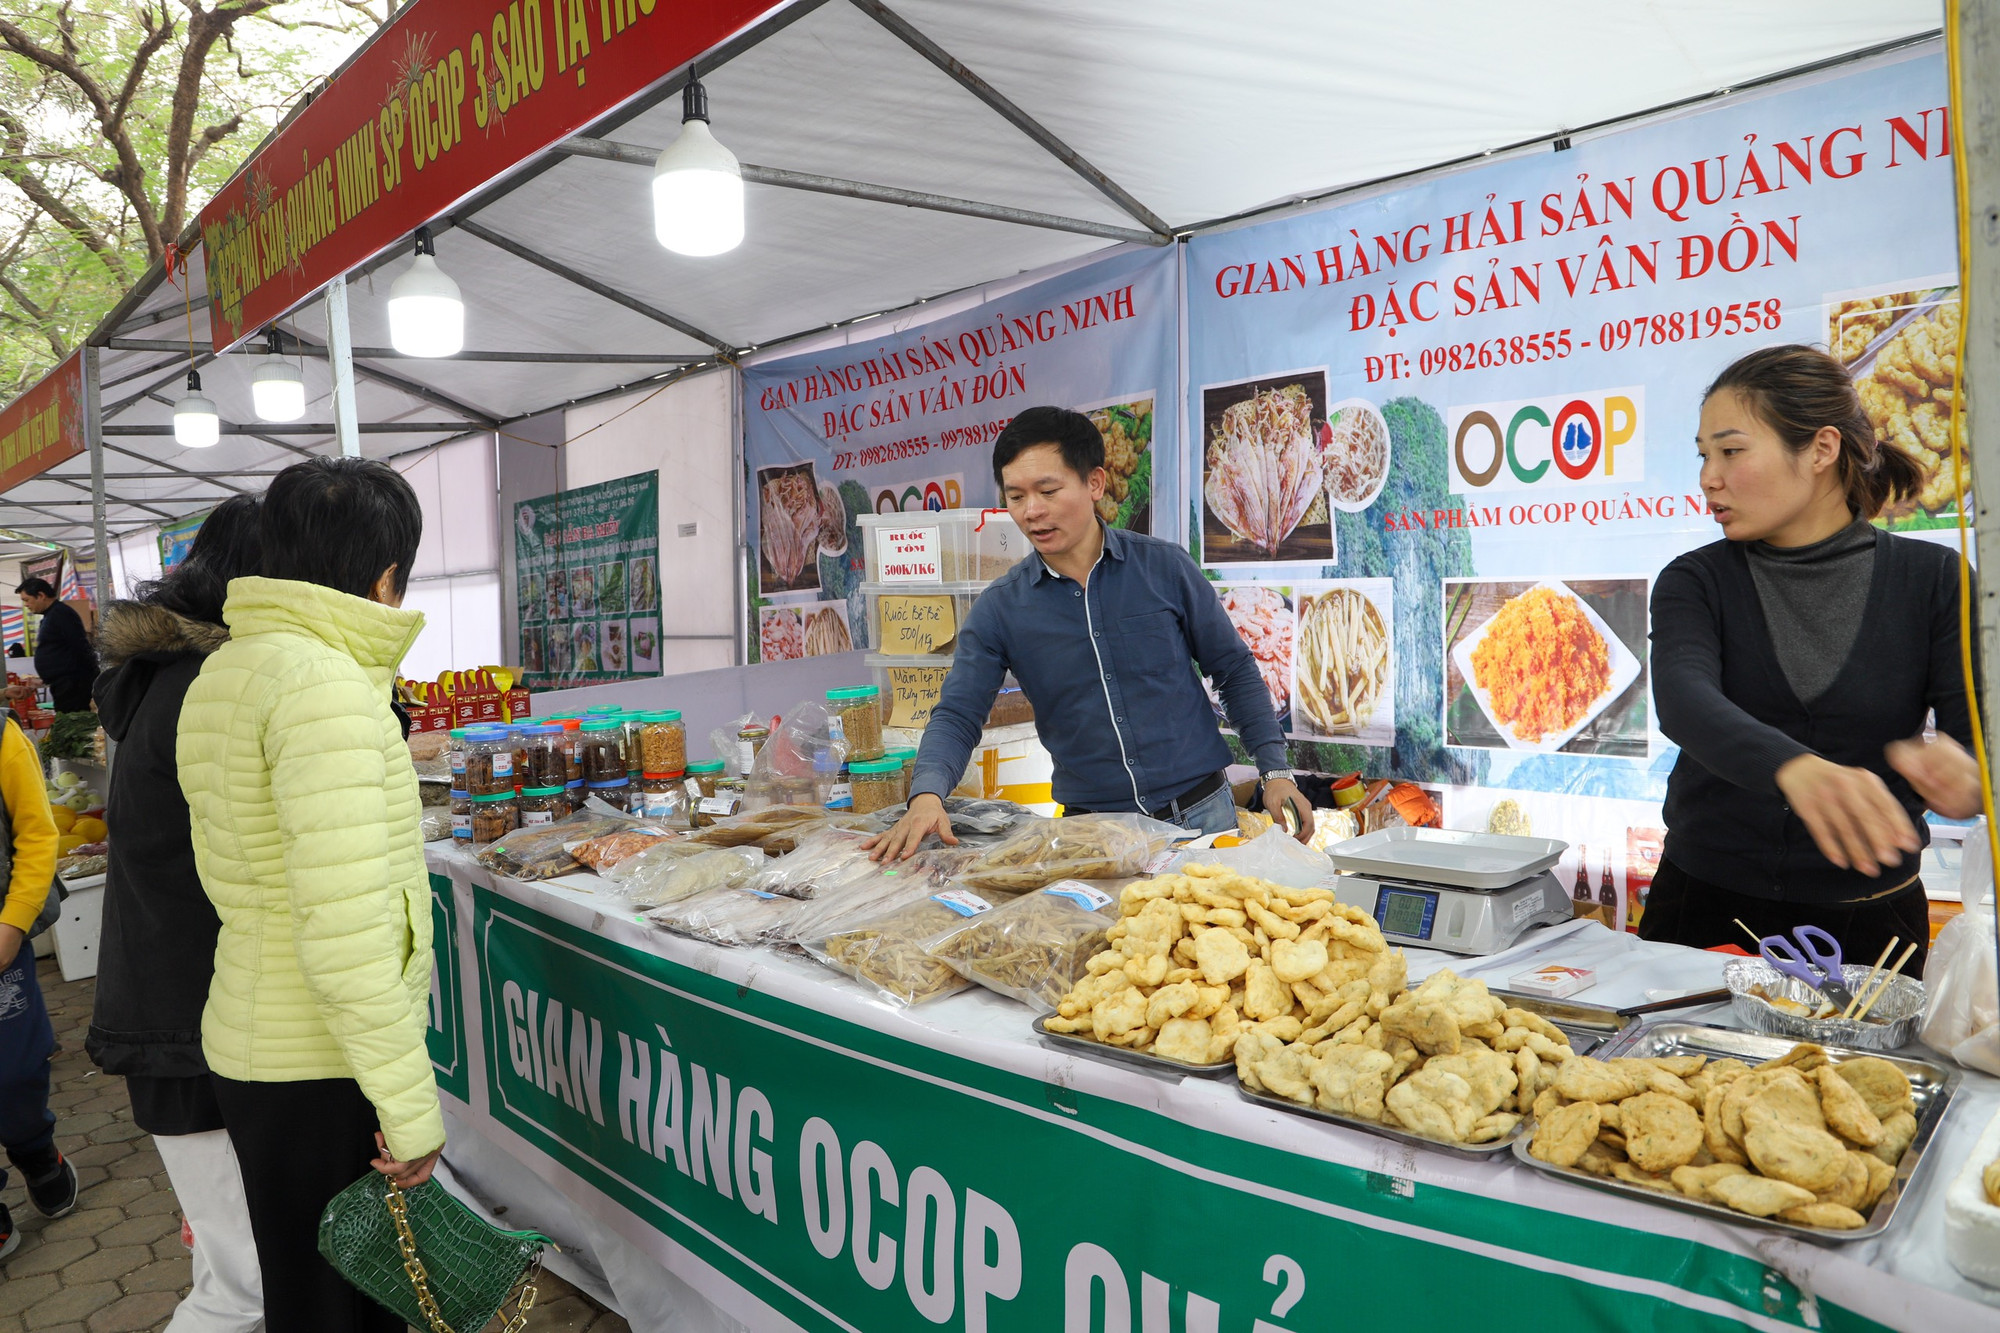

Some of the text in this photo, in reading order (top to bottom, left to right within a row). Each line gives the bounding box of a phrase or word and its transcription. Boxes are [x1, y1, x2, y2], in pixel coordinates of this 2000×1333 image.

[286, 148, 337, 268] QUẢNG
[334, 118, 380, 227] NINH
[379, 96, 405, 193] SP
[408, 47, 466, 172] OCOP
[470, 31, 489, 129] 3
[491, 0, 546, 115] SAO
[1215, 262, 1307, 300] GIAN
[1313, 224, 1431, 286] HÀNG
[1442, 192, 1526, 255] HẢI
[1540, 173, 1636, 238] SẢN
[1652, 133, 1868, 223] QUẢNG
[1349, 212, 1801, 338] ĐẶC SẢN VÂN ĐỒN
[804, 365, 862, 403] HÀNG
[861, 345, 908, 388] HẢI
[905, 335, 955, 376] SẢN
[958, 310, 1058, 368] QUẢNG
[1061, 283, 1138, 333] NINH
[1364, 298, 1782, 384] ĐT: 0982638555 - 0978819558
[823, 360, 1028, 443] ĐẶC SẢN VÂN ĐỒN
[832, 451, 858, 471] ĐT:
[859, 436, 930, 467] 0982638555
[940, 417, 1014, 451] 09788195
[1454, 395, 1638, 488] OCOP
[890, 530, 926, 541] RUỐC
[895, 543, 925, 553] TÔM
[1384, 506, 1427, 533] SẢN
[1508, 502, 1577, 526] OCOP
[1581, 492, 1676, 526] QUẢNG
[884, 563, 936, 576] 500K/1KG
[500, 976, 603, 1126] GIAN
[617, 1022, 779, 1226] HÀNG
[800, 1115, 1022, 1326] OCOP
